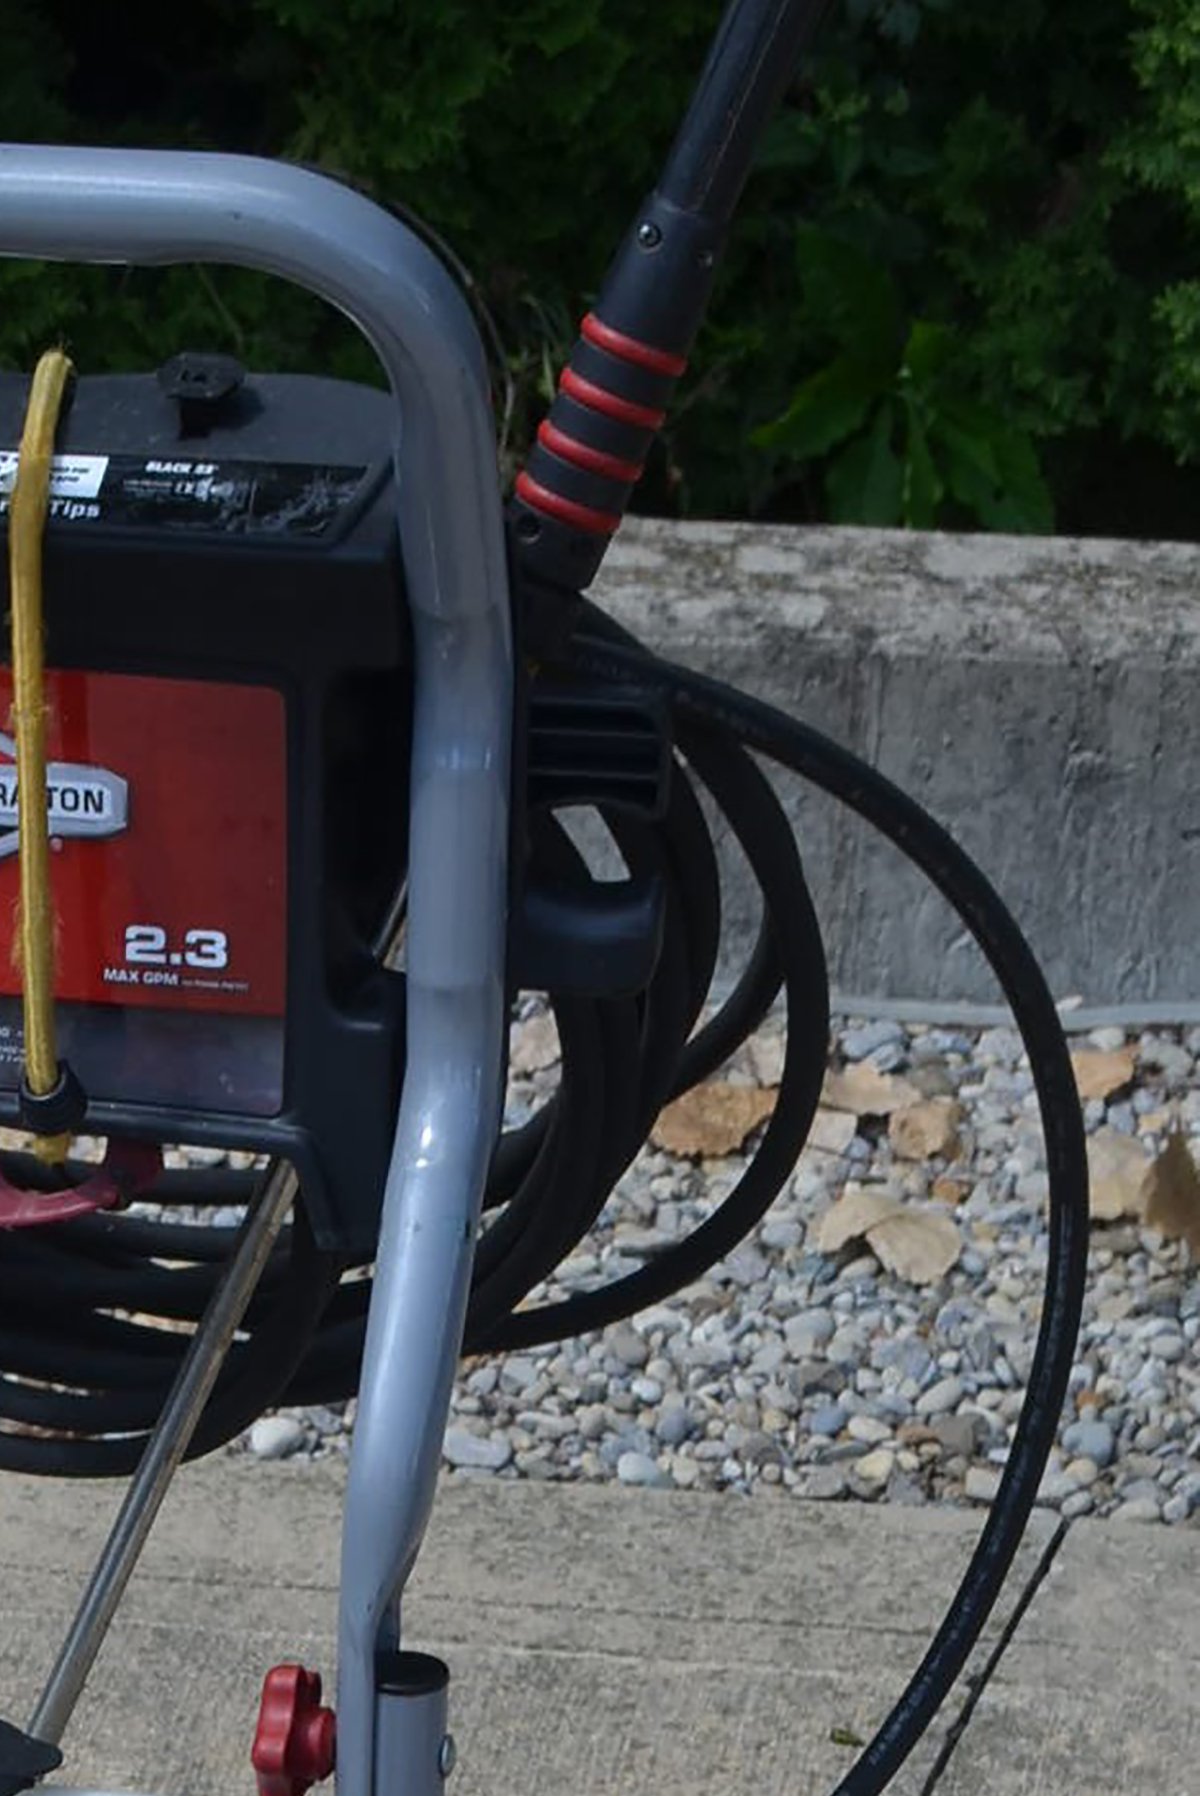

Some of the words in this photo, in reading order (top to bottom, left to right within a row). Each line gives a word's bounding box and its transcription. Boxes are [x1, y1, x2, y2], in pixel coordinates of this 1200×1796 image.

[145, 461, 192, 472] BLACK
[49, 499, 100, 520] Tips
[125, 924, 227, 969] 2.3
[103, 967, 140, 982] MAX
[142, 970, 179, 986] GPM
